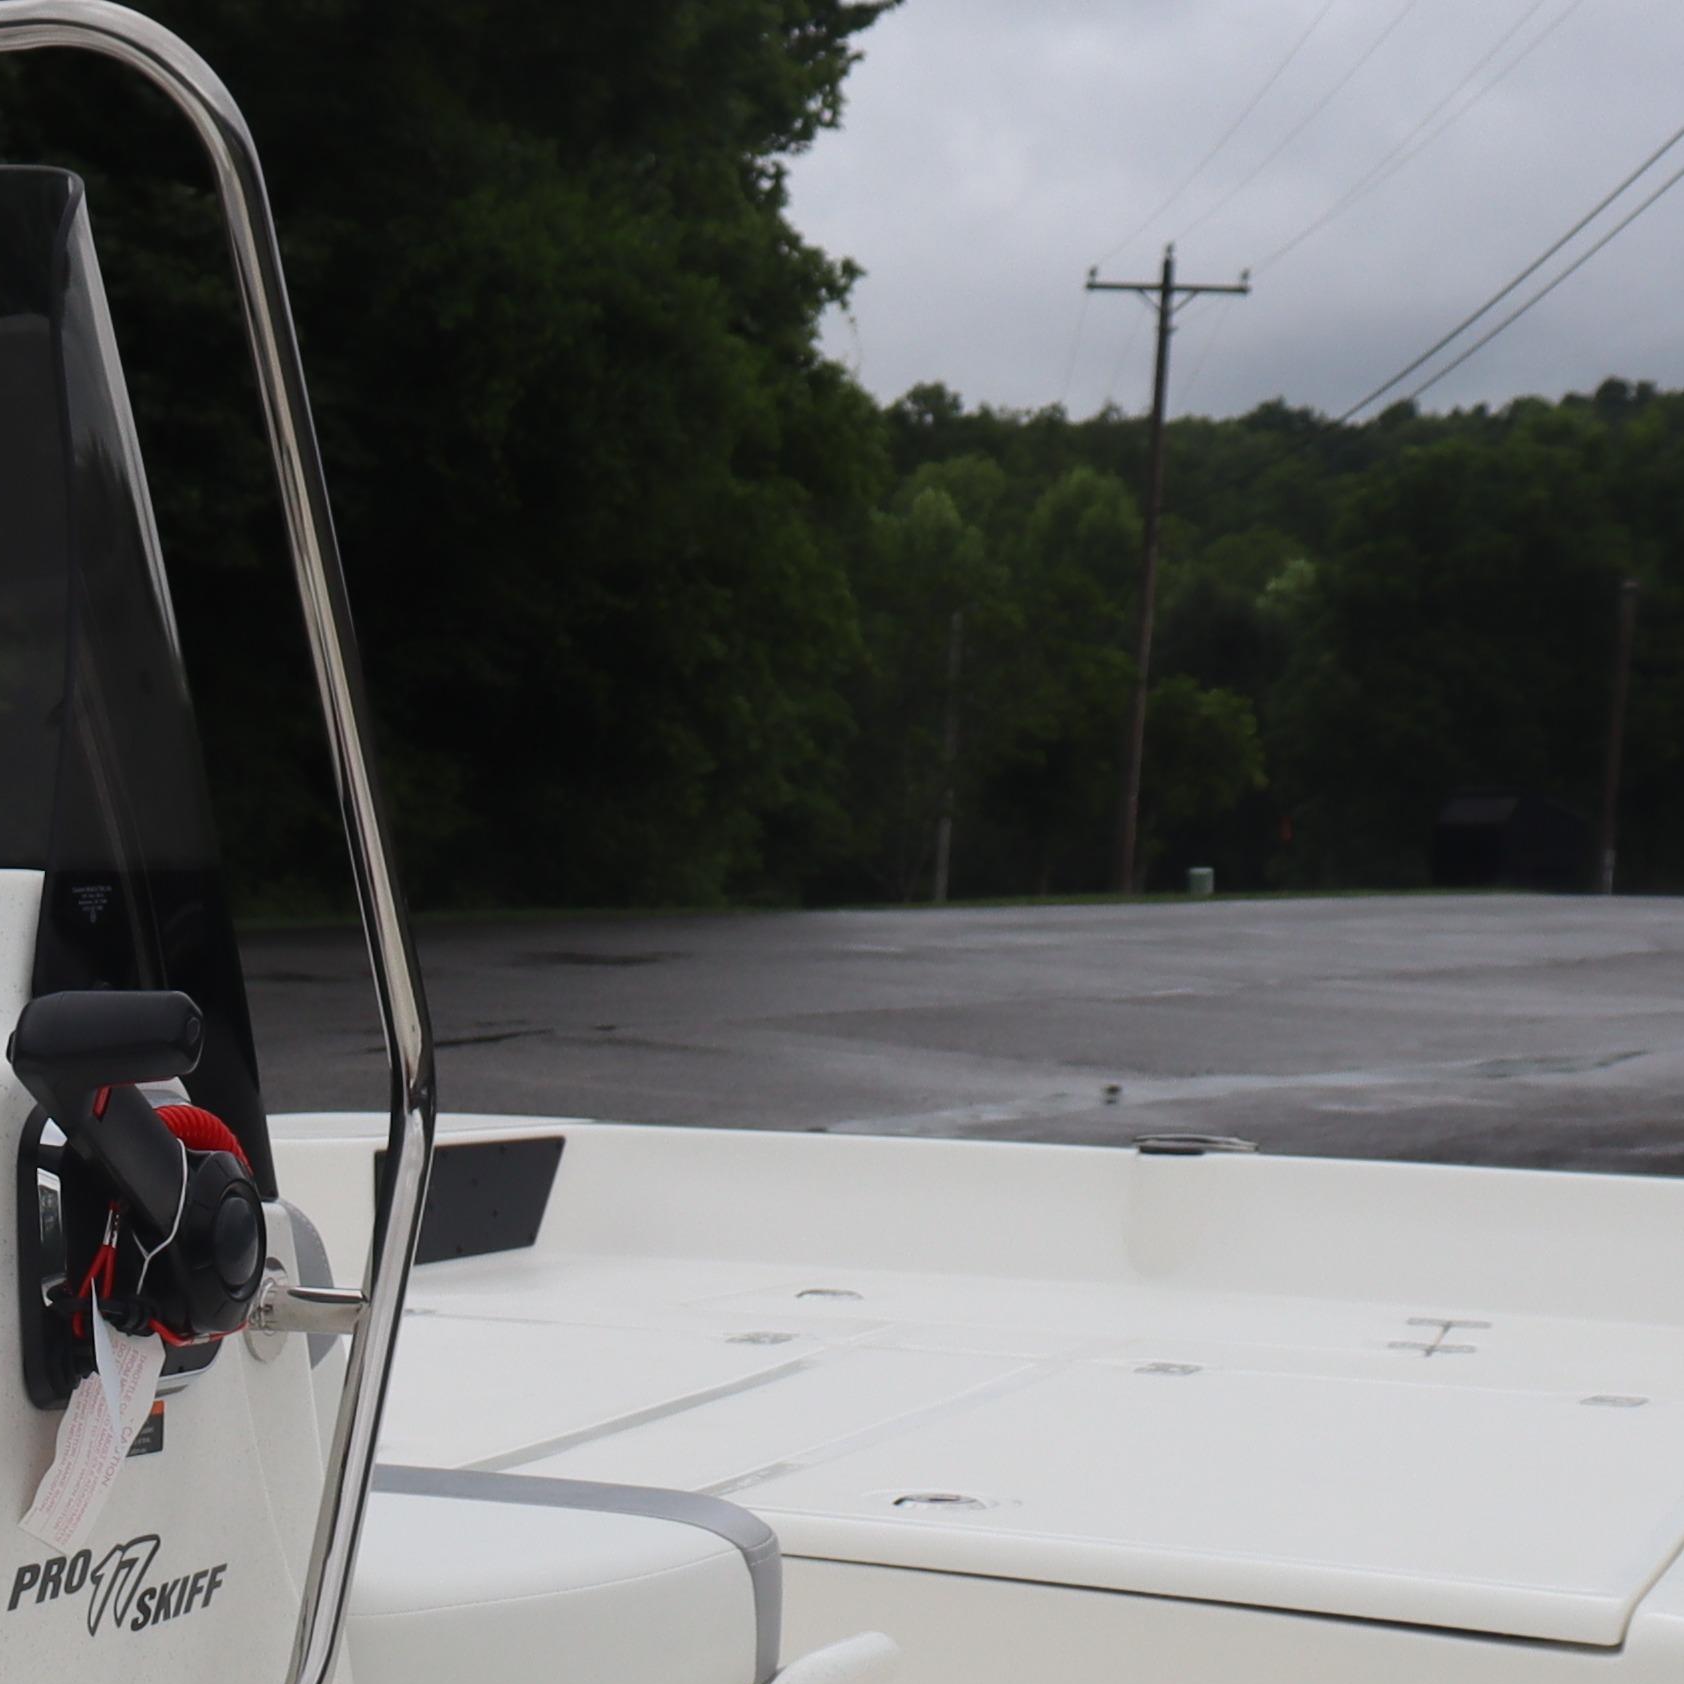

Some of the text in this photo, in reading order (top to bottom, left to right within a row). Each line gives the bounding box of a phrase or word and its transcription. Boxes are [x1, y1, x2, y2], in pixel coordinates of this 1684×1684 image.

[7, 1533, 228, 1637] PRO 17 SKIFF
